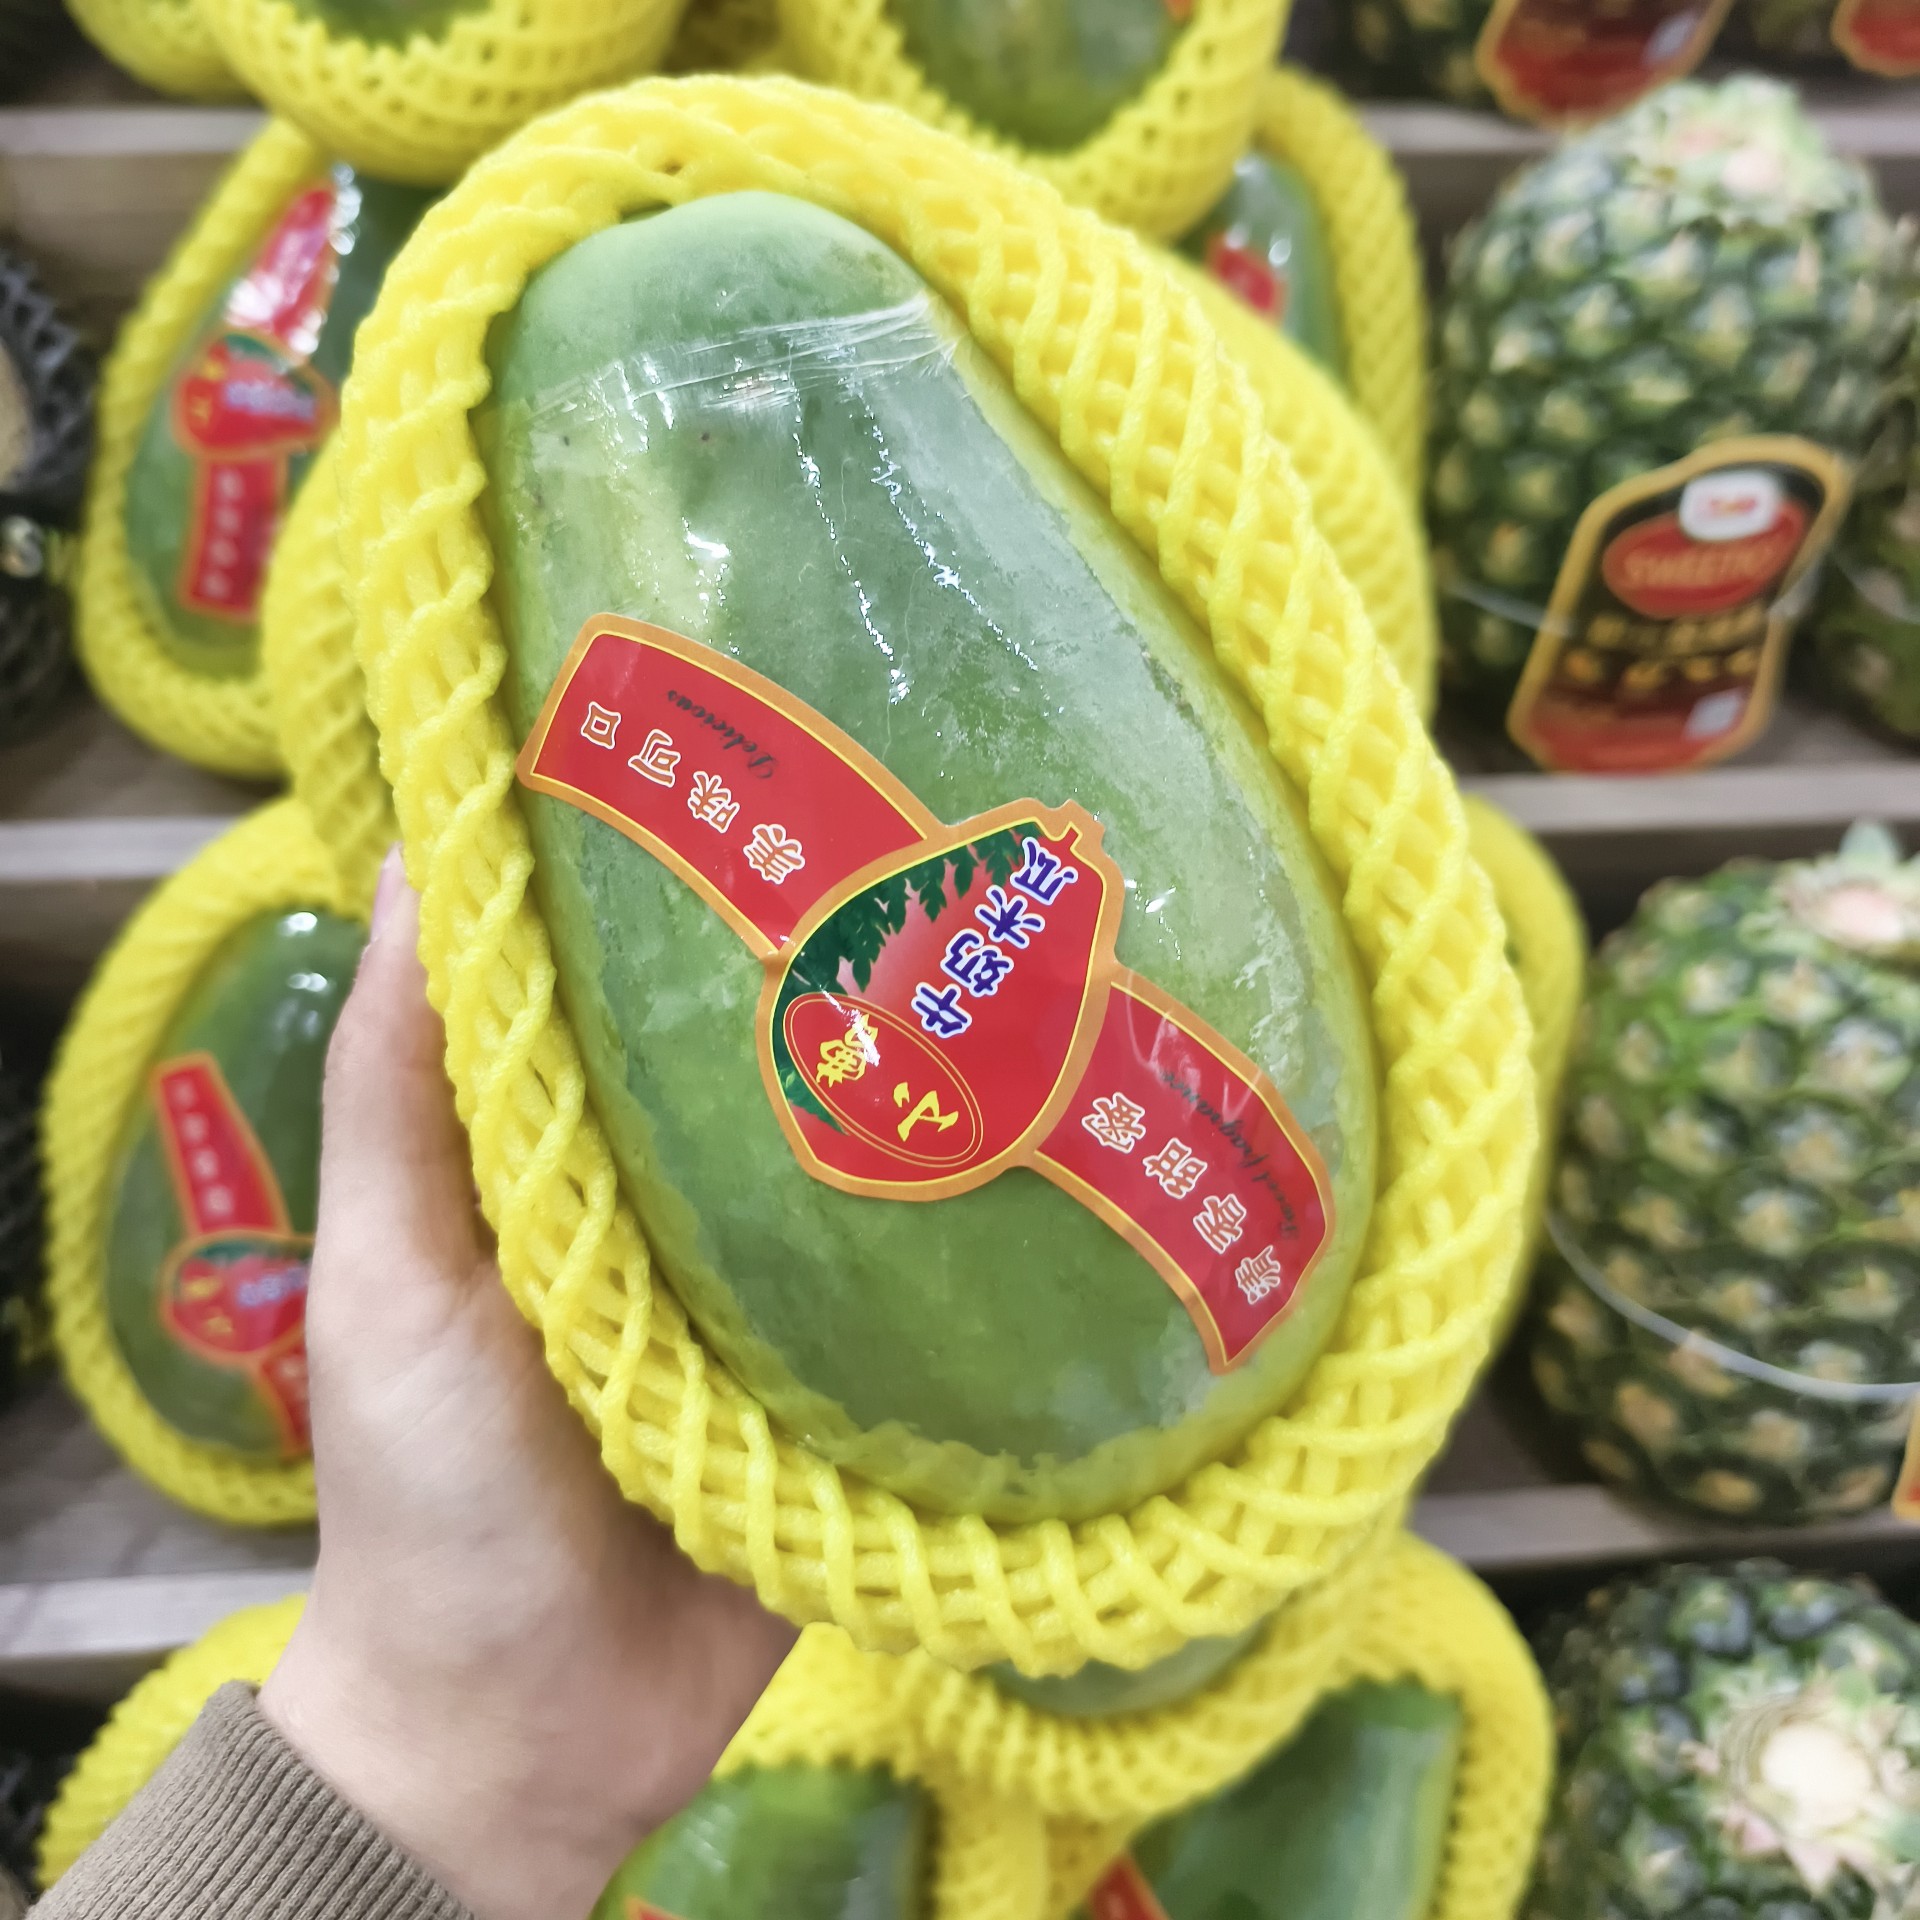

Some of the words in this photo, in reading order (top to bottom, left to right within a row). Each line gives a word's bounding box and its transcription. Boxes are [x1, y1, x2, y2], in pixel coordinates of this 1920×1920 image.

[580, 701, 806, 885] 美味可口
[667, 689, 777, 779] Delicious
[911, 836, 1079, 1039] 牛奶木瓜
[1081, 1091, 1281, 1305] 清香甜蜜
